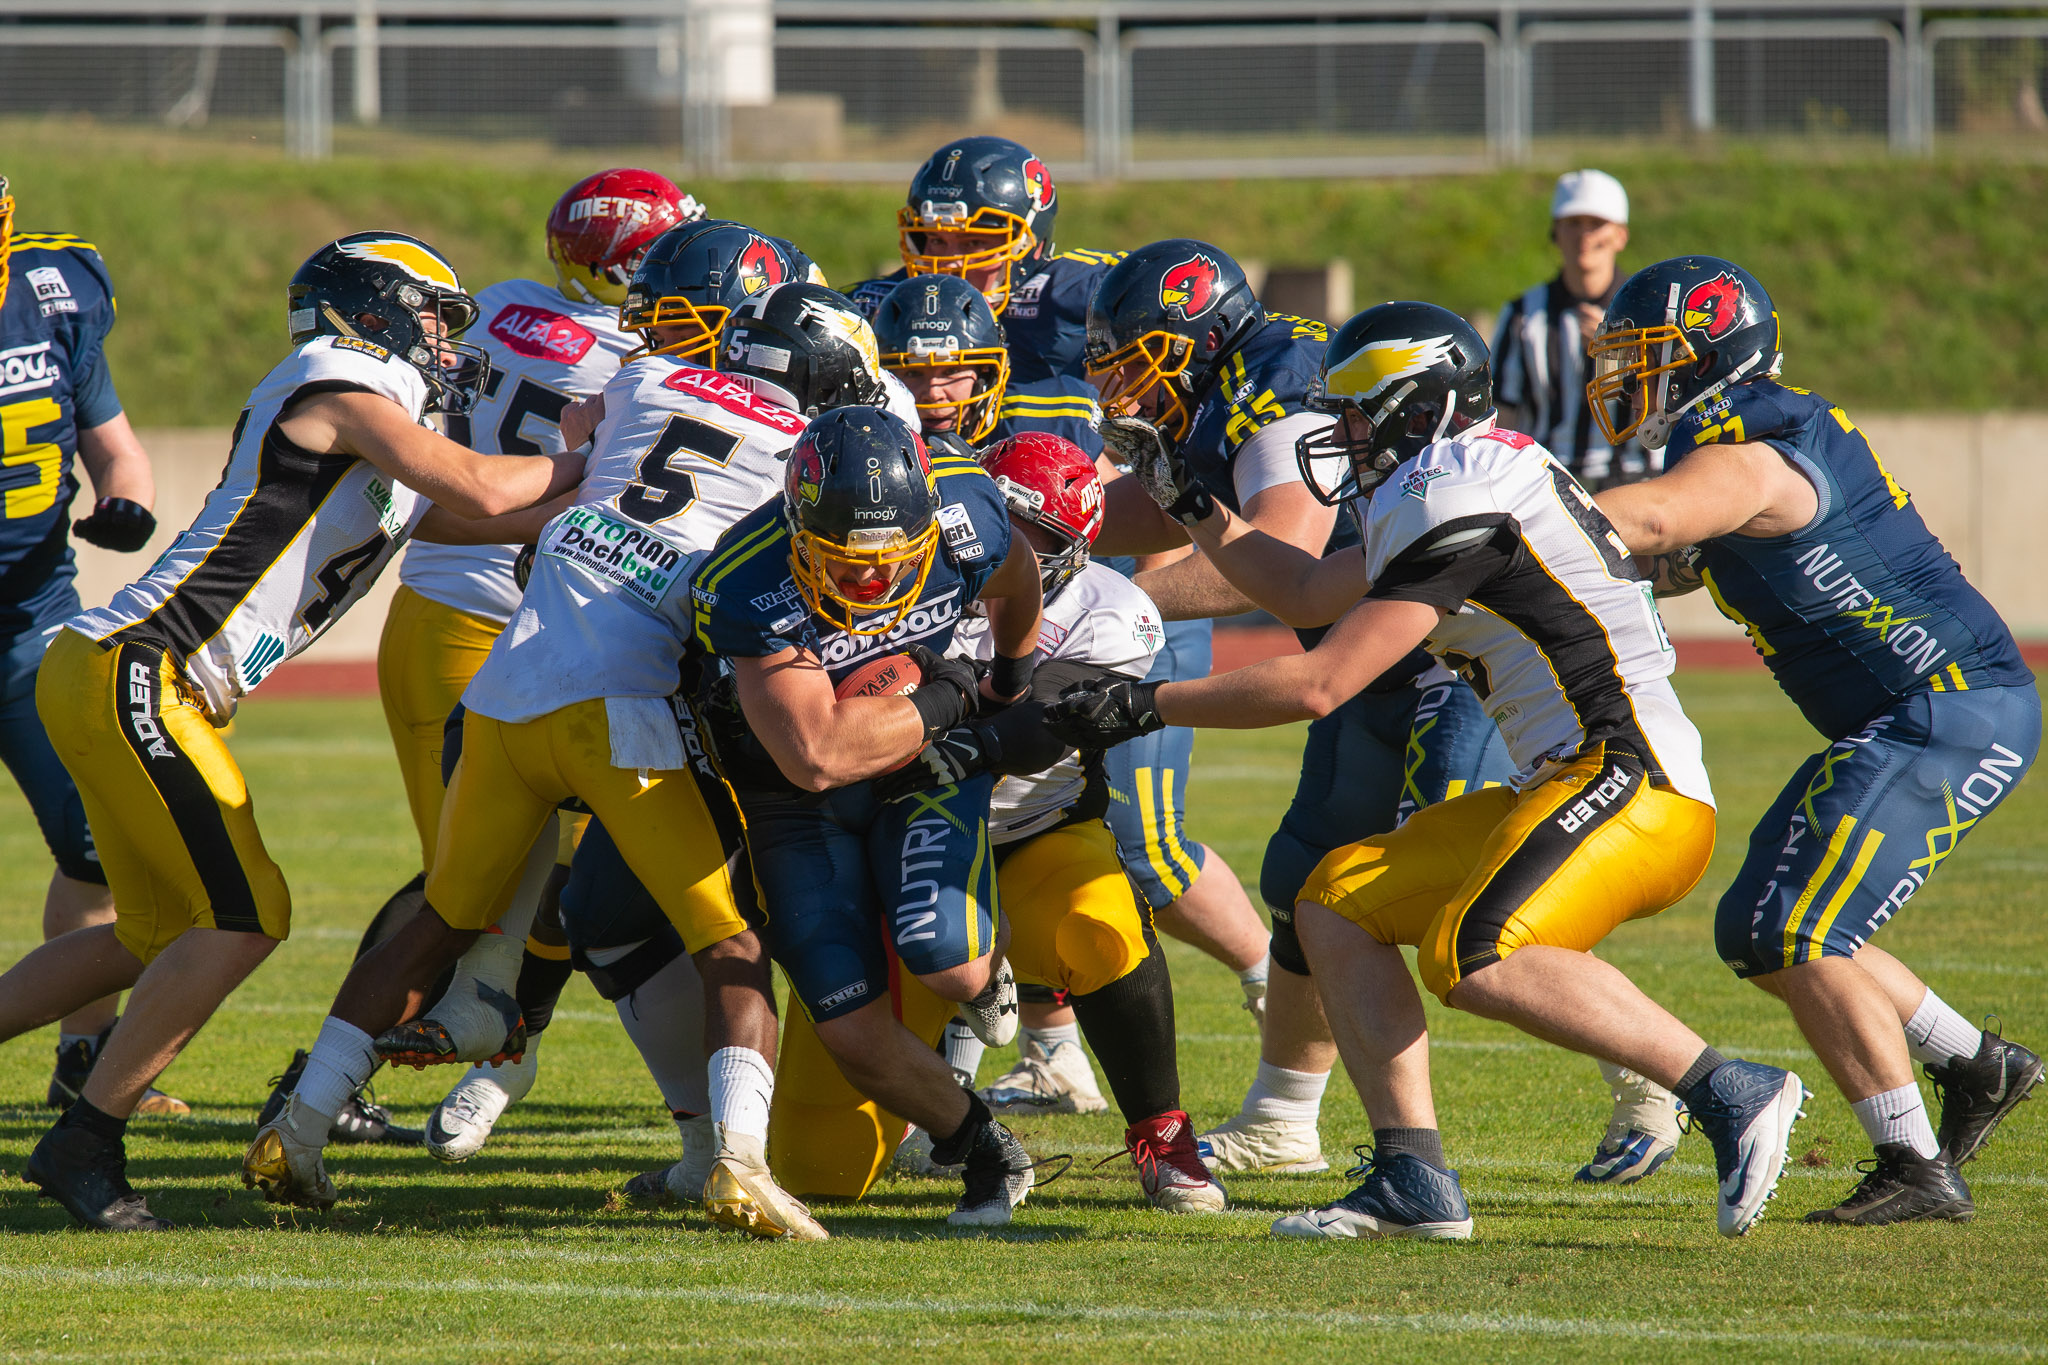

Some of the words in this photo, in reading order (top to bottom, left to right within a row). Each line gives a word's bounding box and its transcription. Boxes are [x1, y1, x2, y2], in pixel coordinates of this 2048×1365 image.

[927, 184, 963, 198] innogy
[569, 196, 652, 225] METS
[36, 282, 67, 296] GFL
[494, 311, 587, 358] ALFA24
[911, 318, 952, 332] innogy
[728, 329, 749, 361] 5
[674, 373, 797, 430] ALFA24
[1694, 398, 1731, 423] TNKD
[613, 411, 746, 529] 5
[1402, 467, 1442, 491] DIATEC
[854, 507, 898, 521] innogy
[944, 522, 975, 543] GFL
[560, 526, 669, 592] Dachbau
[951, 544, 982, 561] TNKD
[552, 544, 658, 604] www.betoplan-dachbau.de
[691, 586, 718, 606] TNKD
[129, 661, 176, 760] ADLER
[1556, 763, 1633, 834] ADLER
[821, 982, 866, 1007] TNKD
[1163, 1119, 1179, 1141] FORCE
